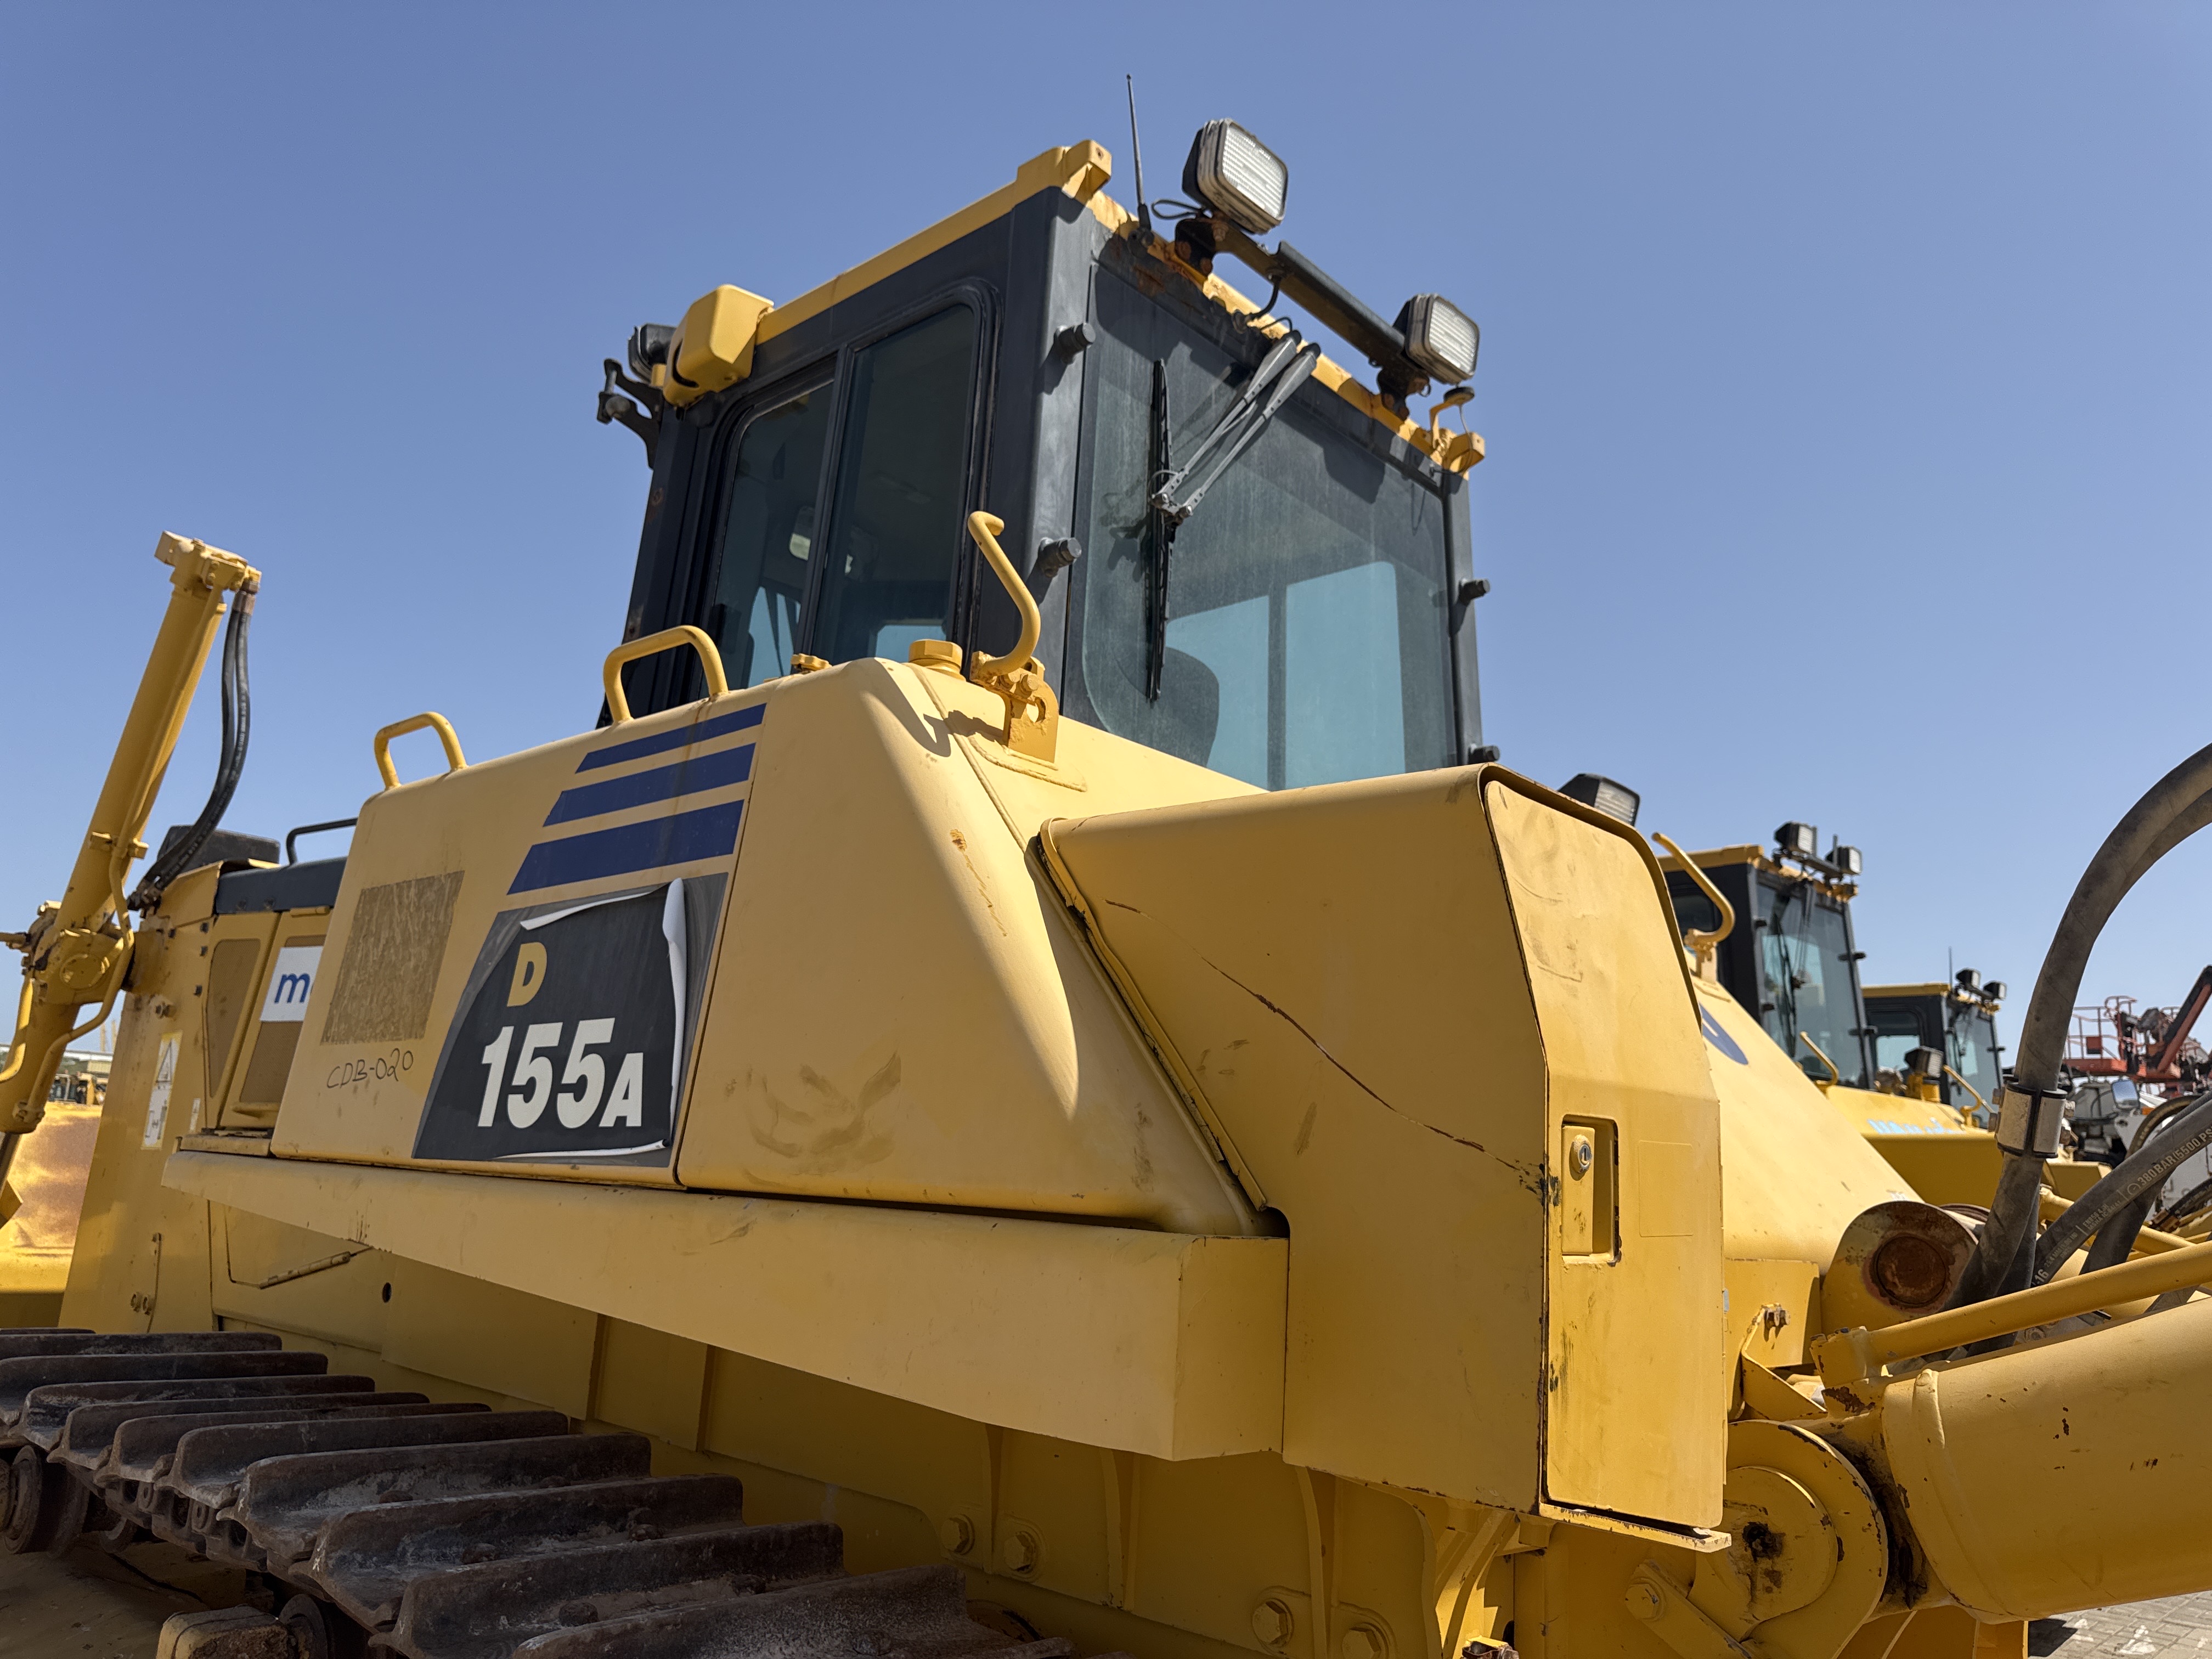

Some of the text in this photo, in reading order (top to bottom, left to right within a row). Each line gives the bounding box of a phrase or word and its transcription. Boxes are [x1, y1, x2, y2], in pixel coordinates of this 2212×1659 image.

[274, 973, 313, 1003] m
[507, 941, 548, 1007] D
[327, 1048, 414, 1088] CDB-020
[477, 1018, 644, 1128] 155A
[2137, 1169, 2157, 1186] 380
[2198, 1126, 2212, 1142] PS
